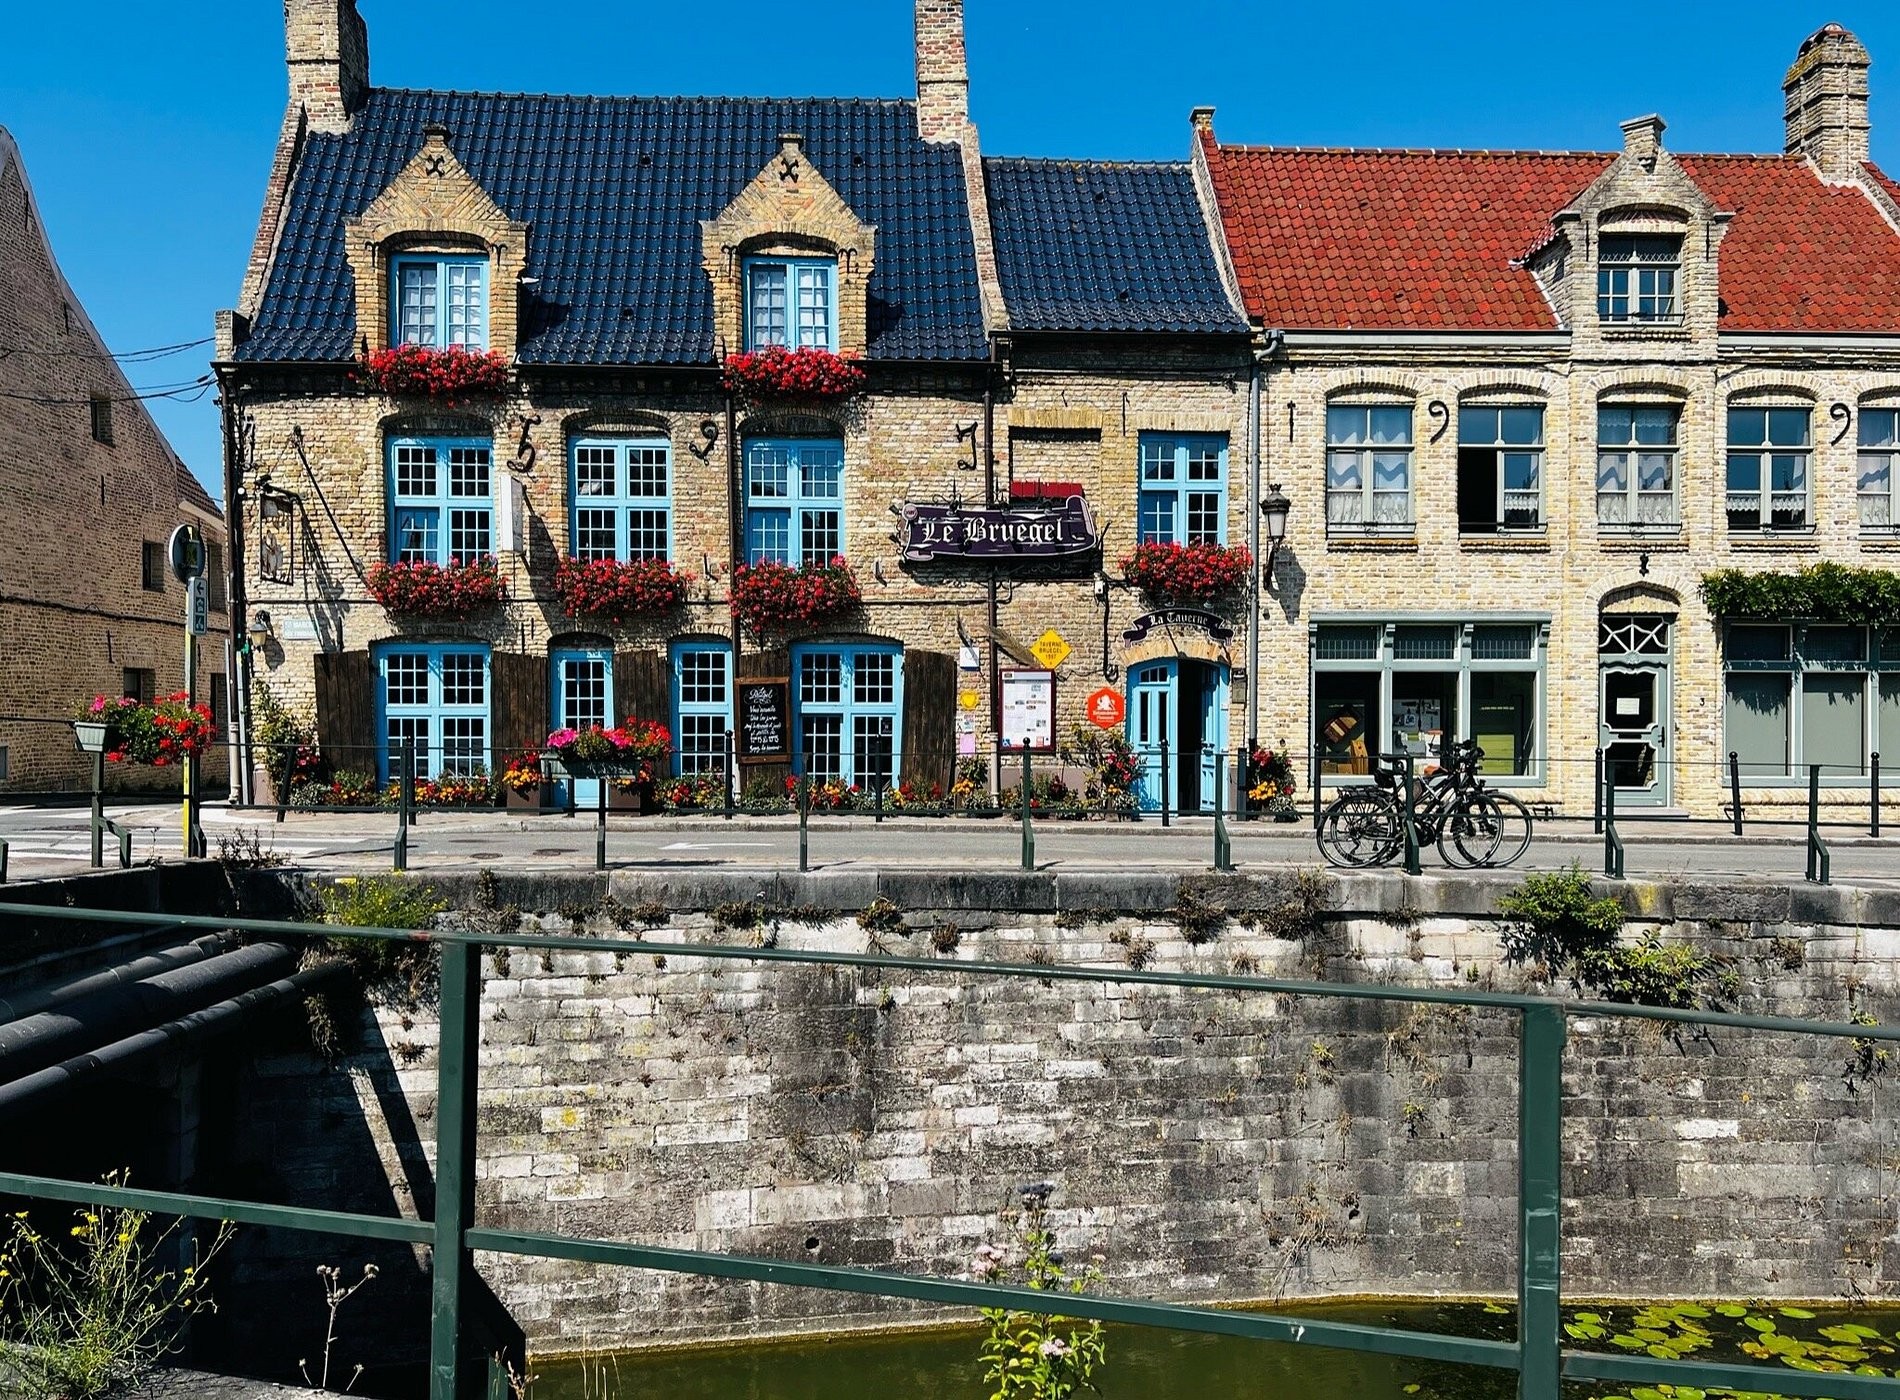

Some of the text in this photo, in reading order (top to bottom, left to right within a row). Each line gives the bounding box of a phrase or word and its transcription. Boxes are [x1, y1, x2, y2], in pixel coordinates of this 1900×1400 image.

[922, 516, 1064, 547] Le Bruegel
[1148, 612, 1208, 627] La Taverne
[1699, 697, 1706, 706] 3
